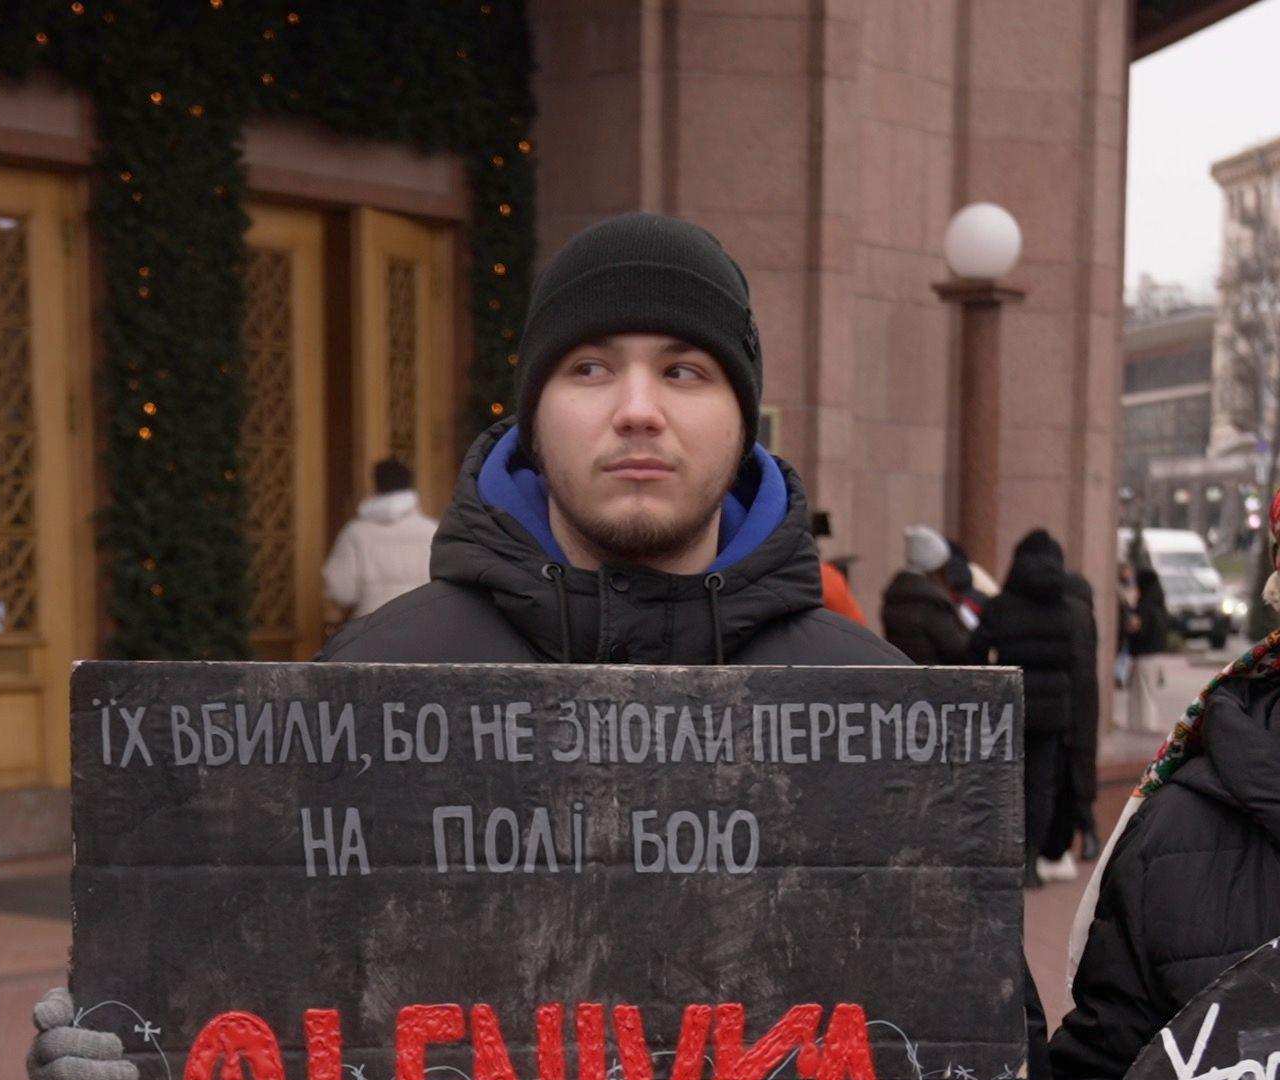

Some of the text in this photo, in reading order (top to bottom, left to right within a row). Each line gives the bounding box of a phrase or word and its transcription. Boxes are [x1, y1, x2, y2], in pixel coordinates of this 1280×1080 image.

[92, 698, 1015, 777] ЇХ ВБИЛИ, БО НЕ ЗМОГЛИ ПЕРЕМОГТИ
[300, 806, 372, 877] НА
[632, 809, 761, 874] БОЮ
